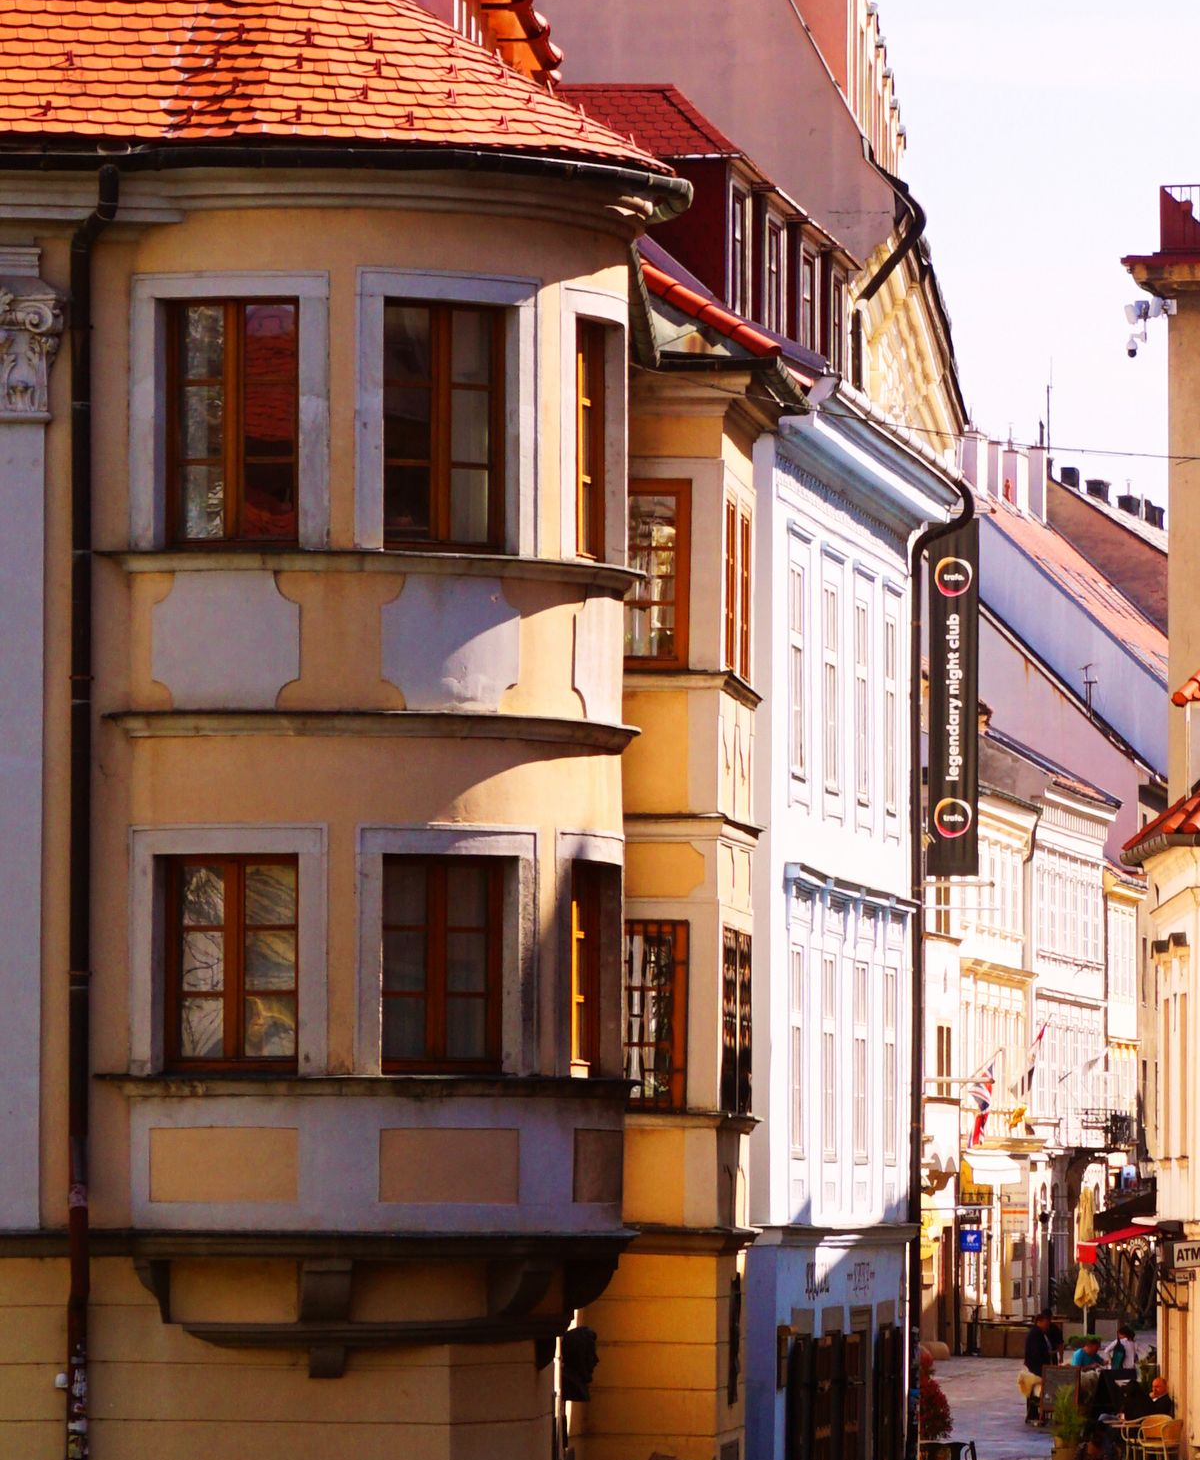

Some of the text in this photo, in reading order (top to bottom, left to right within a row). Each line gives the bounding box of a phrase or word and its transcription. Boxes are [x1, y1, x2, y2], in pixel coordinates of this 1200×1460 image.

[945, 613, 963, 781] legendary night club
